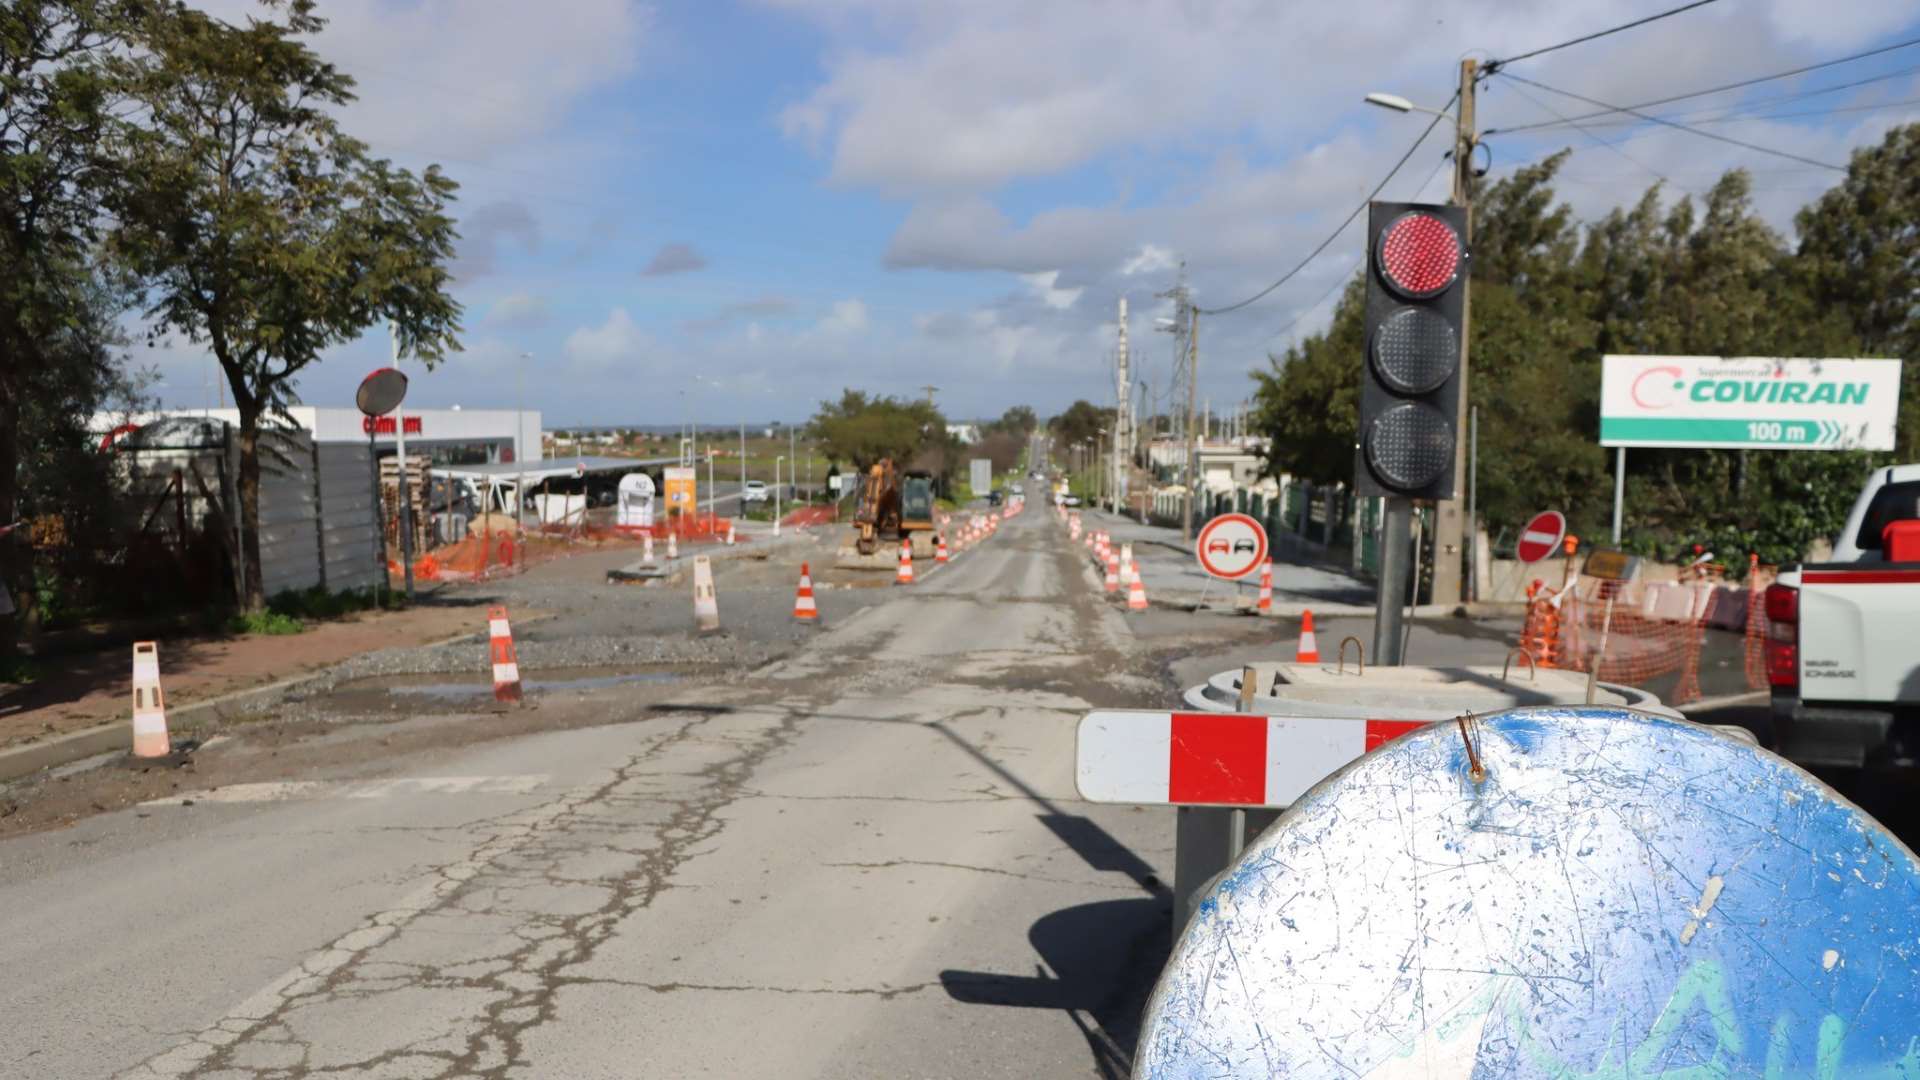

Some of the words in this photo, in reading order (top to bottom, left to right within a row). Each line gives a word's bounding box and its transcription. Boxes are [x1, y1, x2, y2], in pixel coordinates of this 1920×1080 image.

[1690, 380, 1870, 405] COVIRAN
[1748, 422, 1781, 441] 100
[1786, 427, 1806, 441] m
